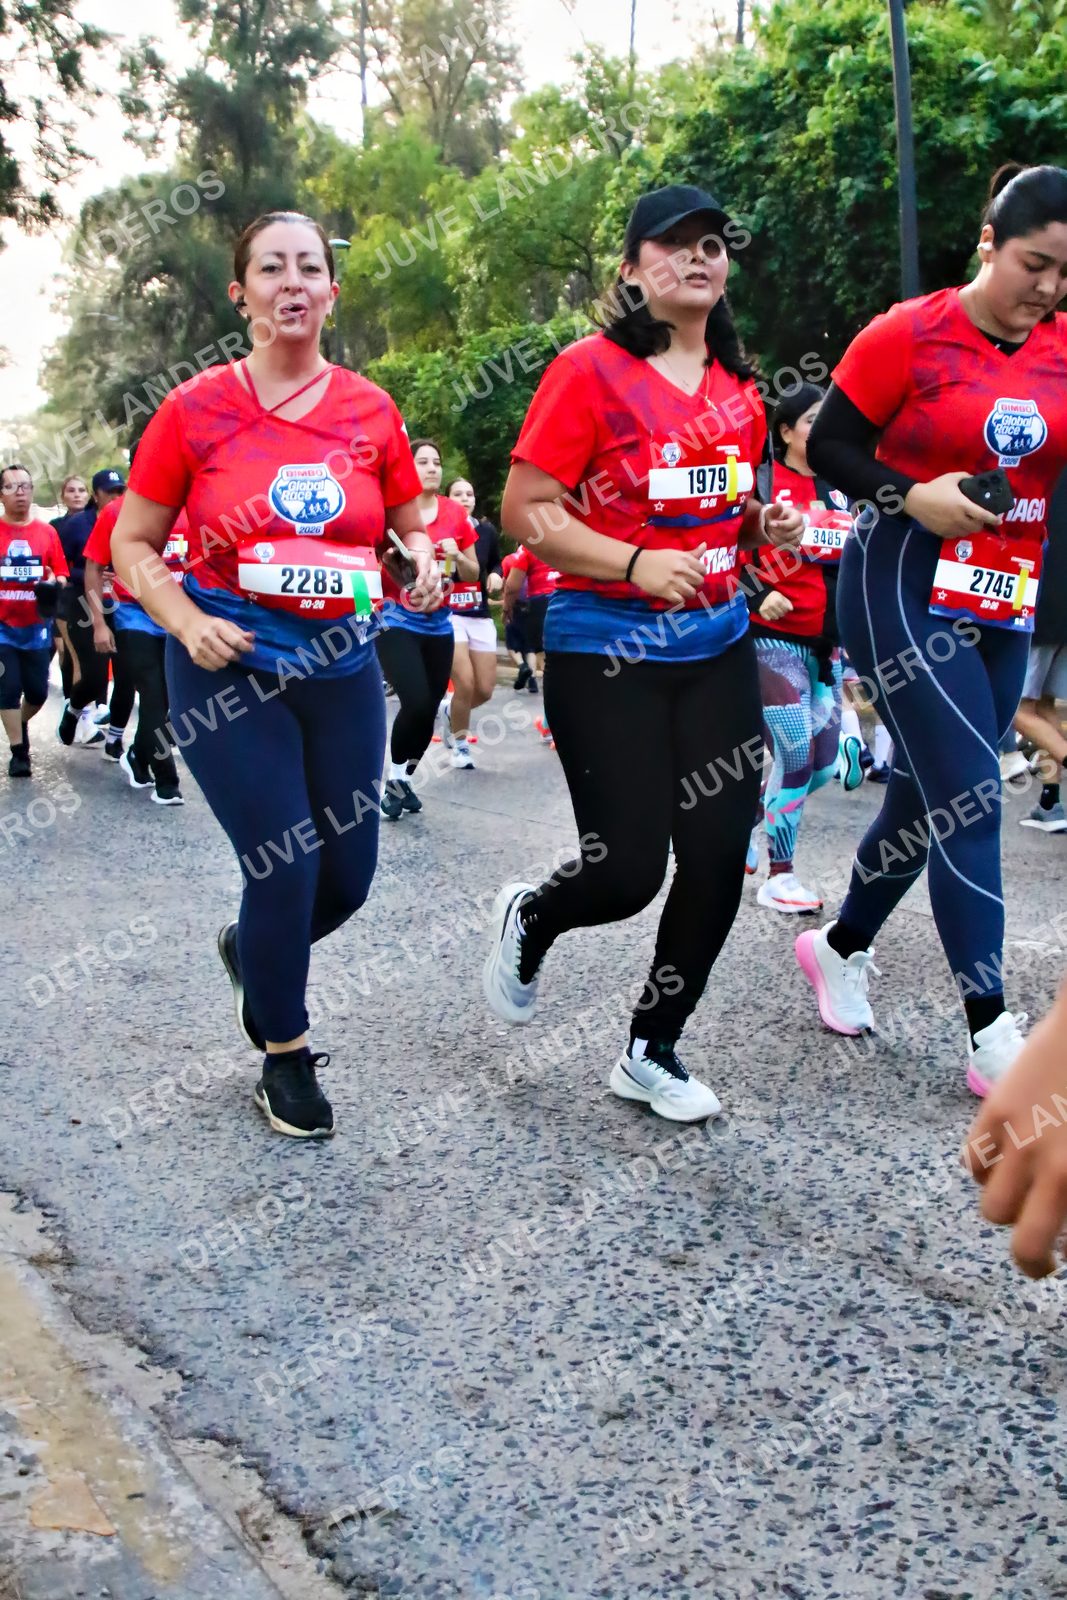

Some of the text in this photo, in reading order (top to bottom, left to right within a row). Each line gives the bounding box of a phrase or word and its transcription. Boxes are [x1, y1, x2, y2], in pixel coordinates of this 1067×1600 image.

[1001, 414, 1034, 427] Global
[994, 423, 1021, 436] Race
[286, 470, 323, 478] BIMBO
[688, 466, 728, 495] 1979
[287, 479, 325, 492] Global
[281, 490, 312, 502] Race
[300, 525, 322, 534] 2026
[813, 529, 841, 546] 3485
[280, 567, 343, 595] 2283
[969, 568, 1016, 600] 2745
[300, 599, 325, 610] 20-26
